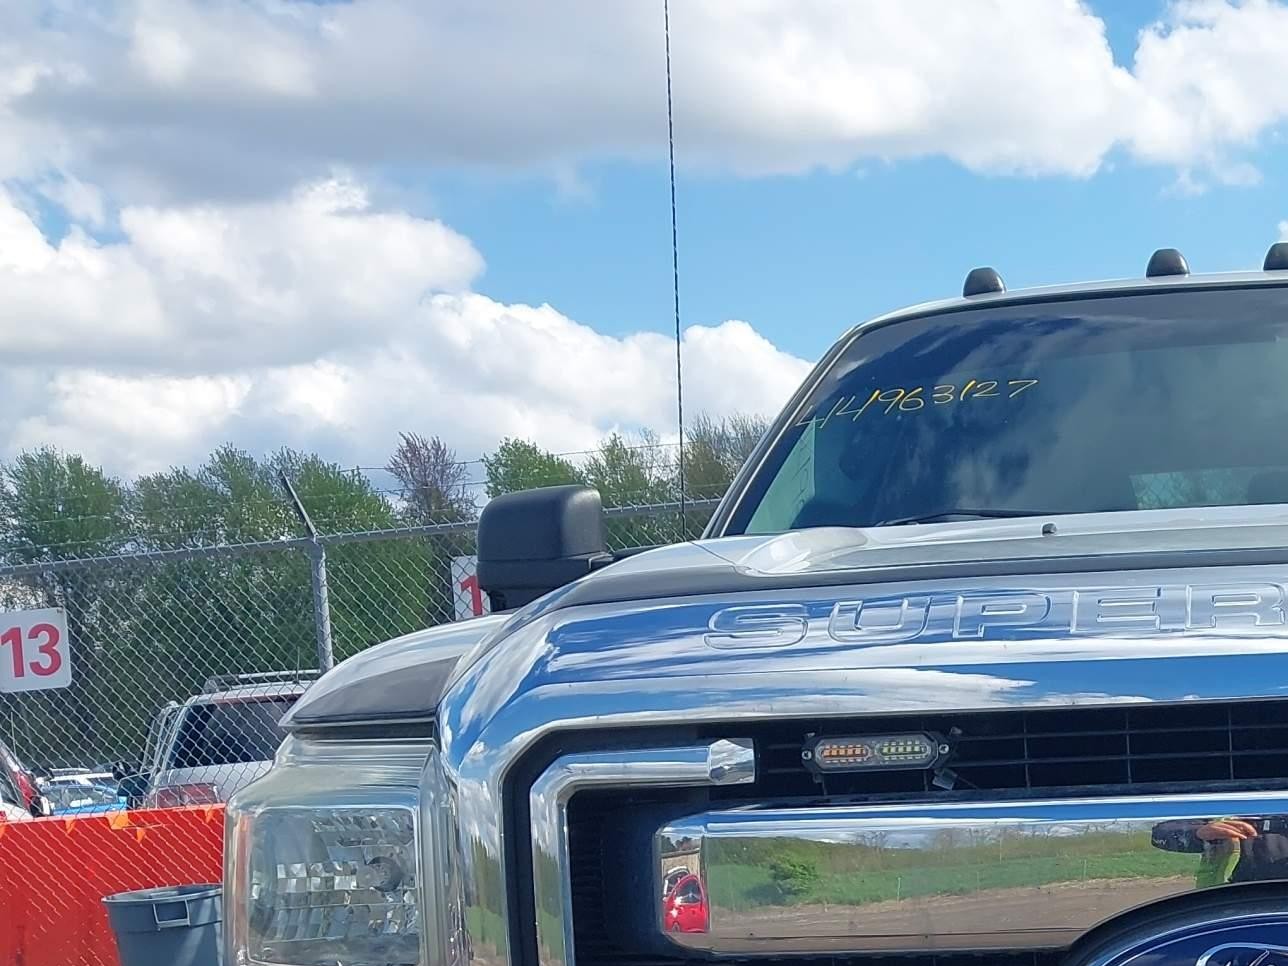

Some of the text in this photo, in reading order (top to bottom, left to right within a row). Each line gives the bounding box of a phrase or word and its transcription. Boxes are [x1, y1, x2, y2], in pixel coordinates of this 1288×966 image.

[796, 379, 1039, 429] 44963127
[703, 582, 1287, 650] SUPER
[0, 622, 63, 678] 13
